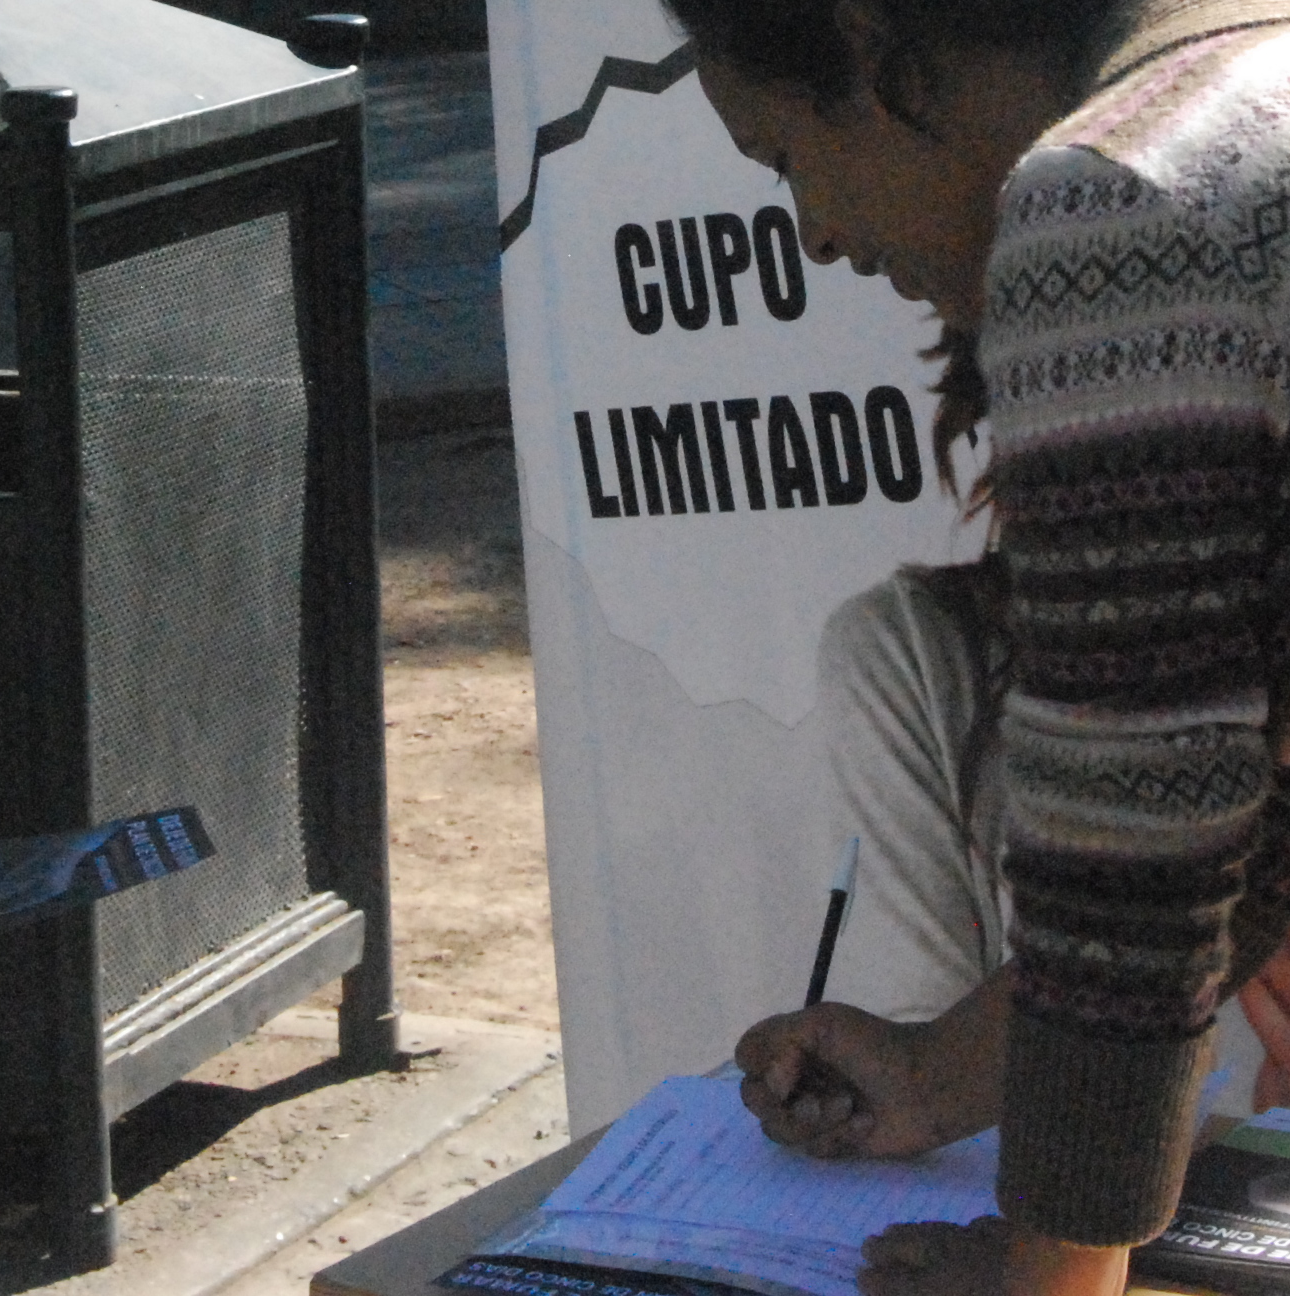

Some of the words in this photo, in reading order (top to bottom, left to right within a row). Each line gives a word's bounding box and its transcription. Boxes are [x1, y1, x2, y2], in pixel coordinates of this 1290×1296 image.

[614, 205, 807, 335] CUPO
[573, 385, 924, 519] LIMITADO
[1183, 1221, 1256, 1242] CINCO
[1221, 1242, 1266, 1256] DE
